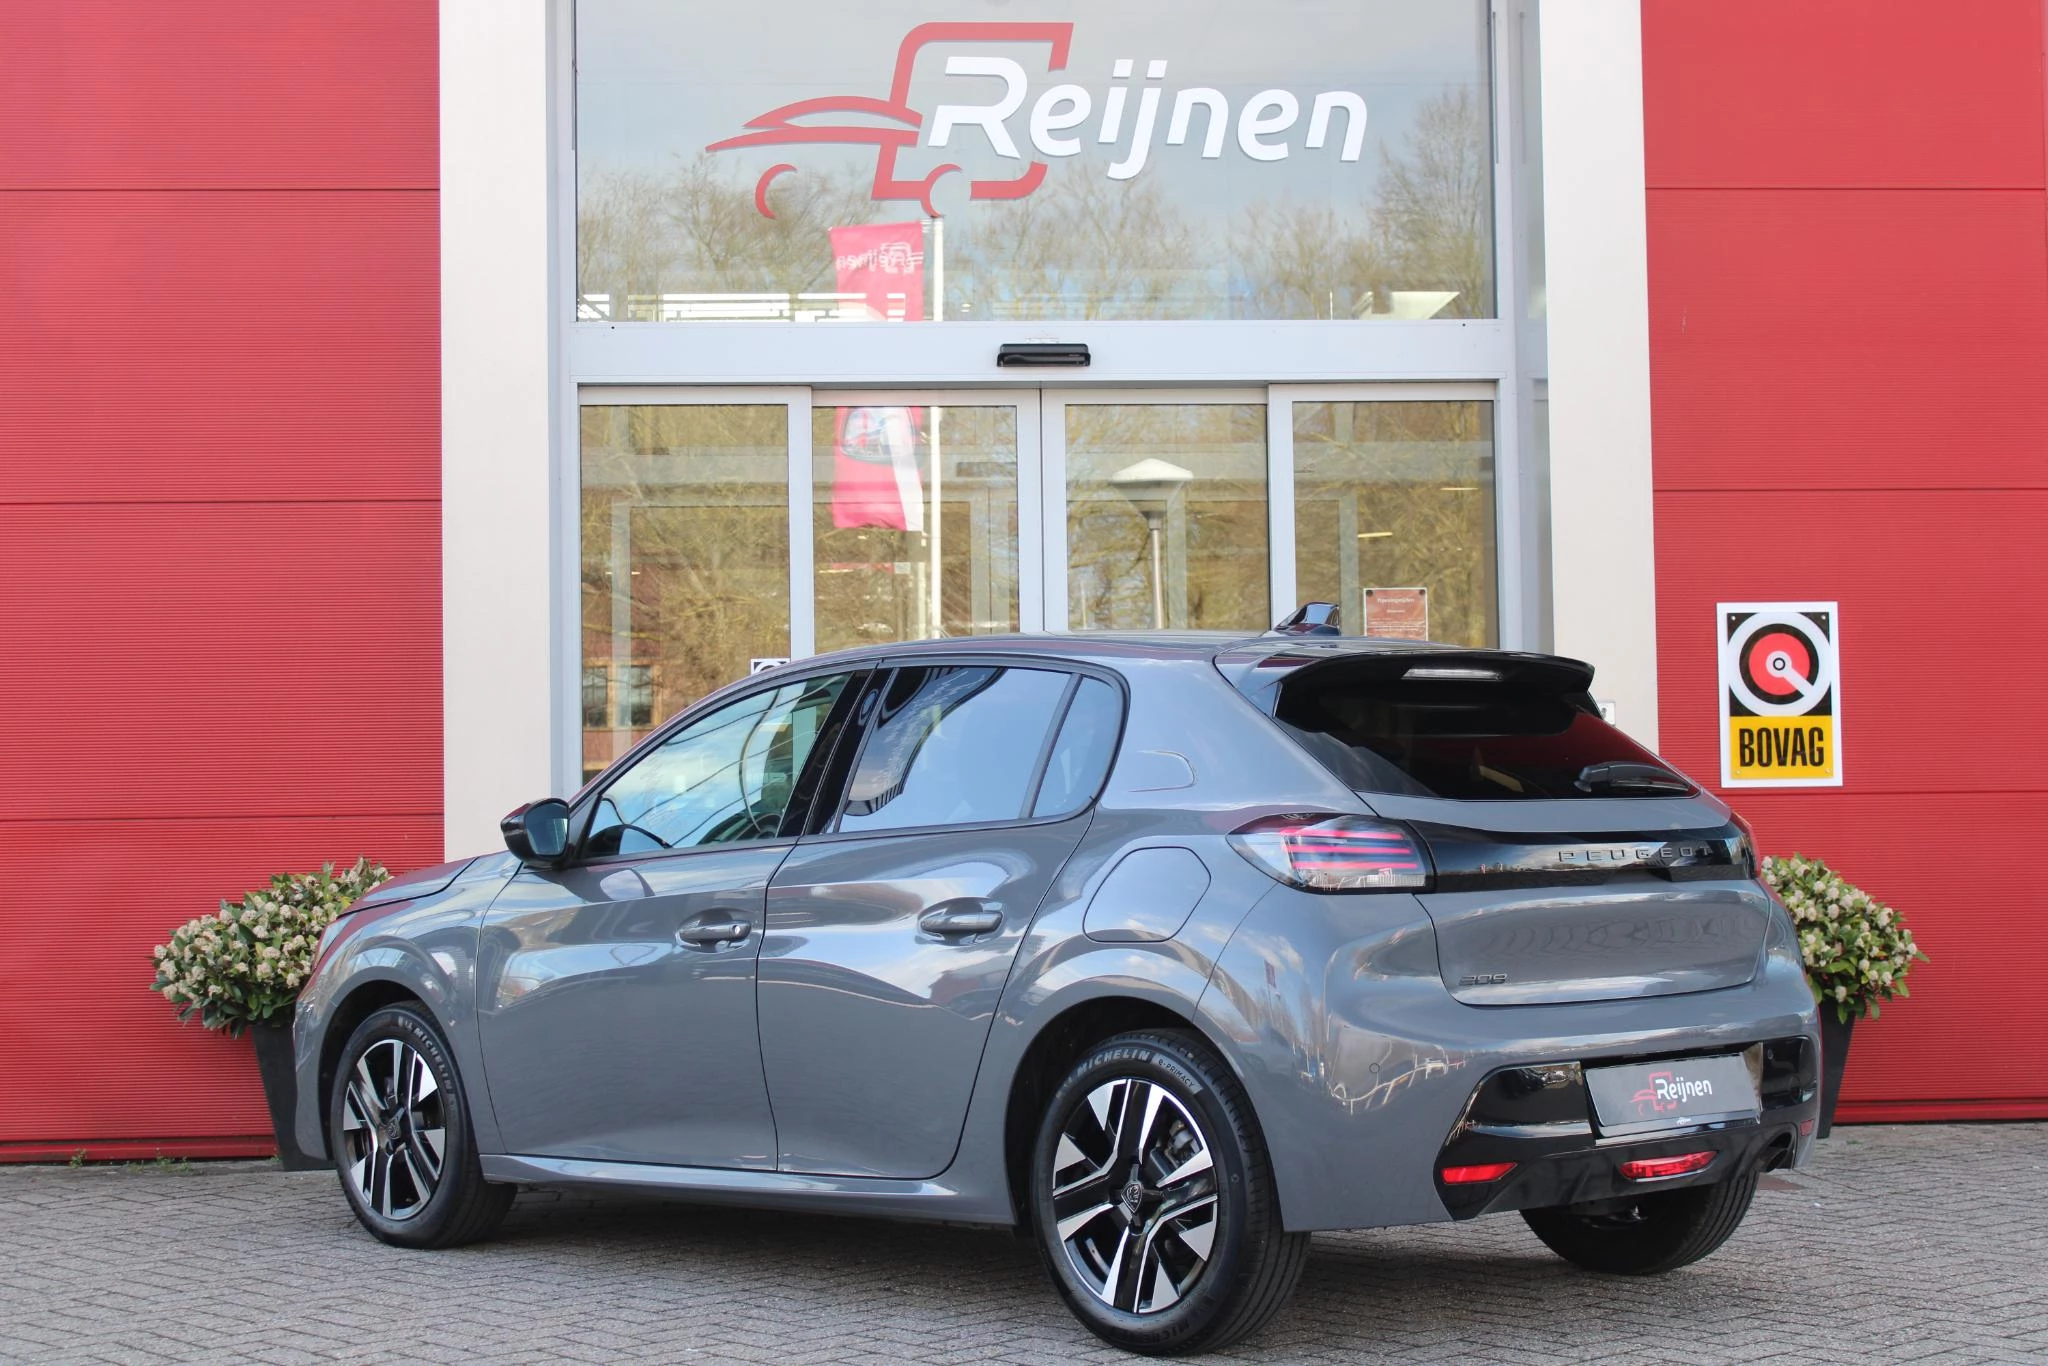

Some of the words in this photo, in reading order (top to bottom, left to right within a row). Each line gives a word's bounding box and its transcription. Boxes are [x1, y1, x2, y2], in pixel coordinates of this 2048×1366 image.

[928, 56, 1367, 180] Reijnen
[1739, 727, 1825, 767] BOVAG
[1558, 845, 1713, 863] PEUGEOT
[414, 1027, 452, 1090] MICHELIN
[1076, 1049, 1150, 1076] MICHELIN
[1655, 1076, 1713, 1103] Reijnen
